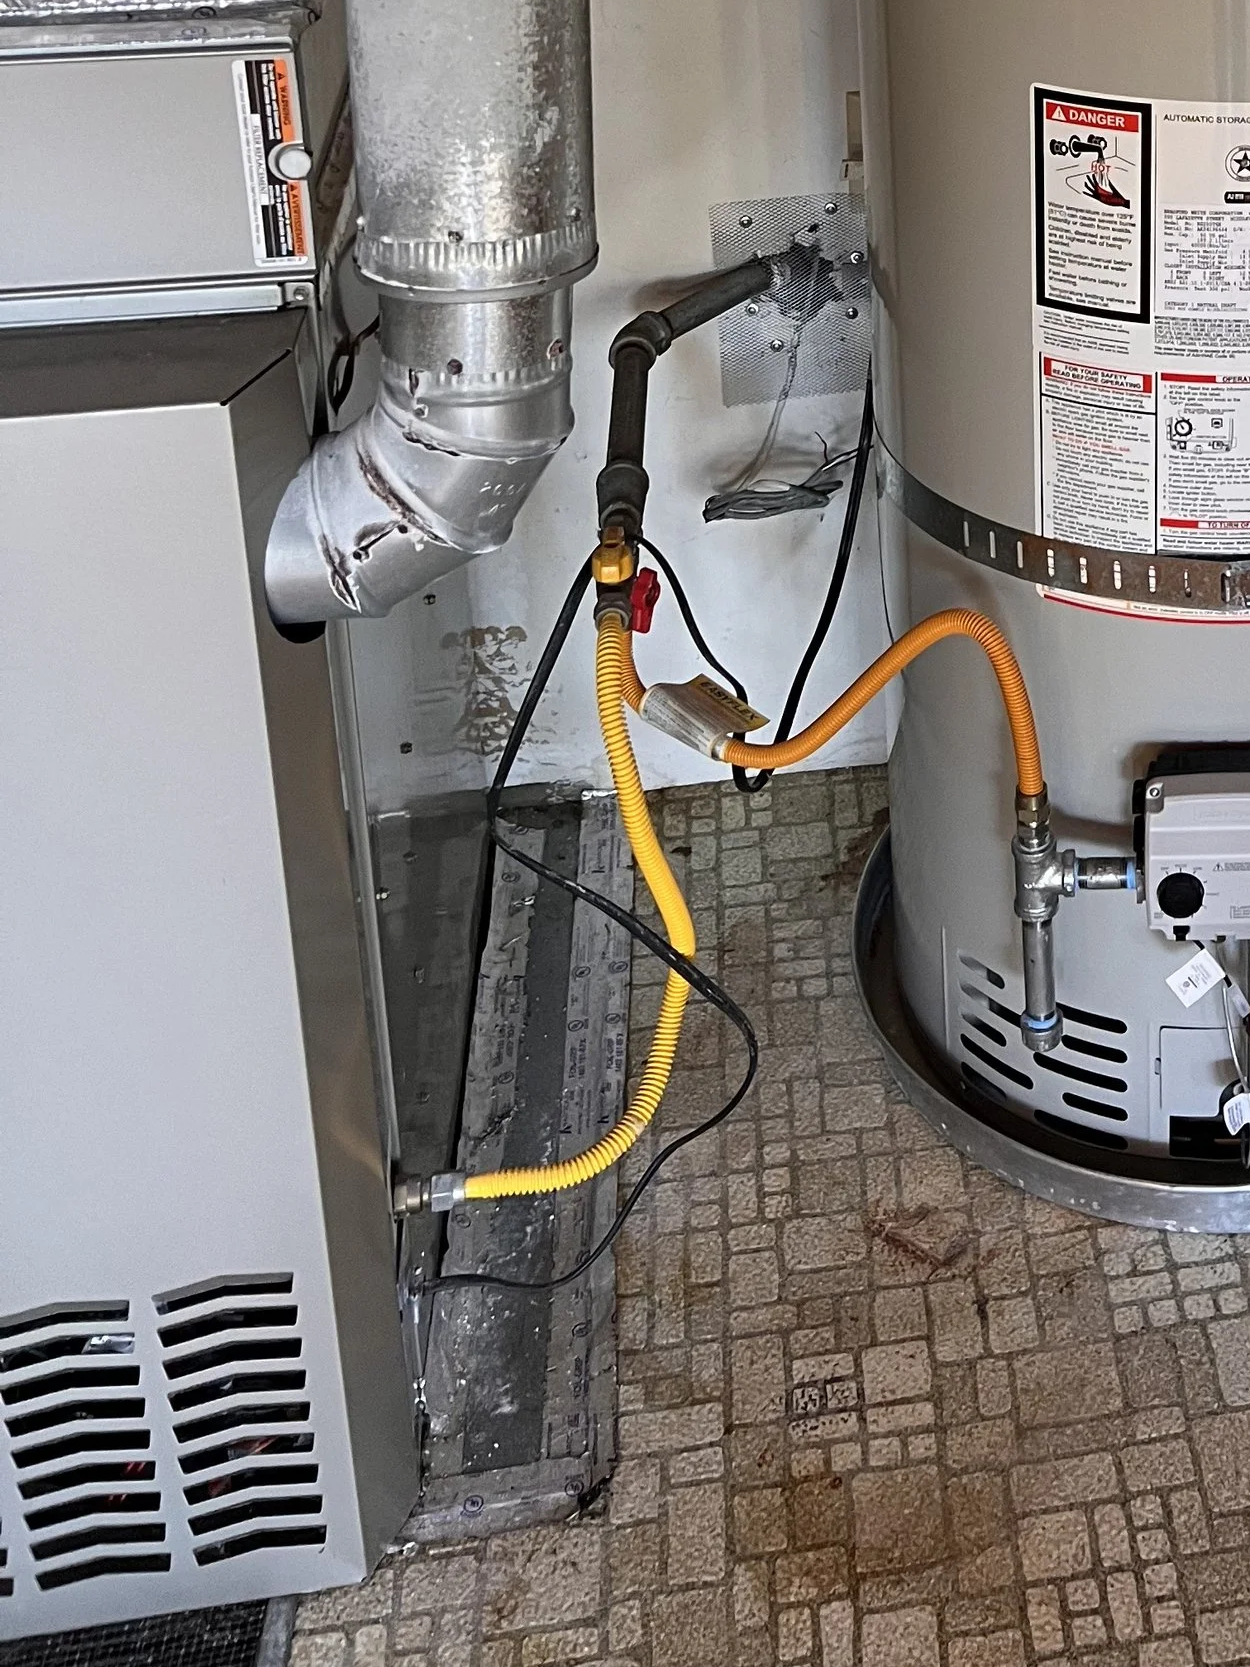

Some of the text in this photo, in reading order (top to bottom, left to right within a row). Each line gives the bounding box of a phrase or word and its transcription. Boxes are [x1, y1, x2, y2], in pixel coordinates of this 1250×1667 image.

[280, 86, 291, 125] WARNING
[1069, 110, 1125, 127] DANGER
[1164, 114, 1214, 123] AUTOMATIC
[252, 126, 266, 194] FILTER REPLACEMENT
[1052, 369, 1141, 389] READ BEFORE OPERATING
[1101, 372, 1127, 380] SAFETY
